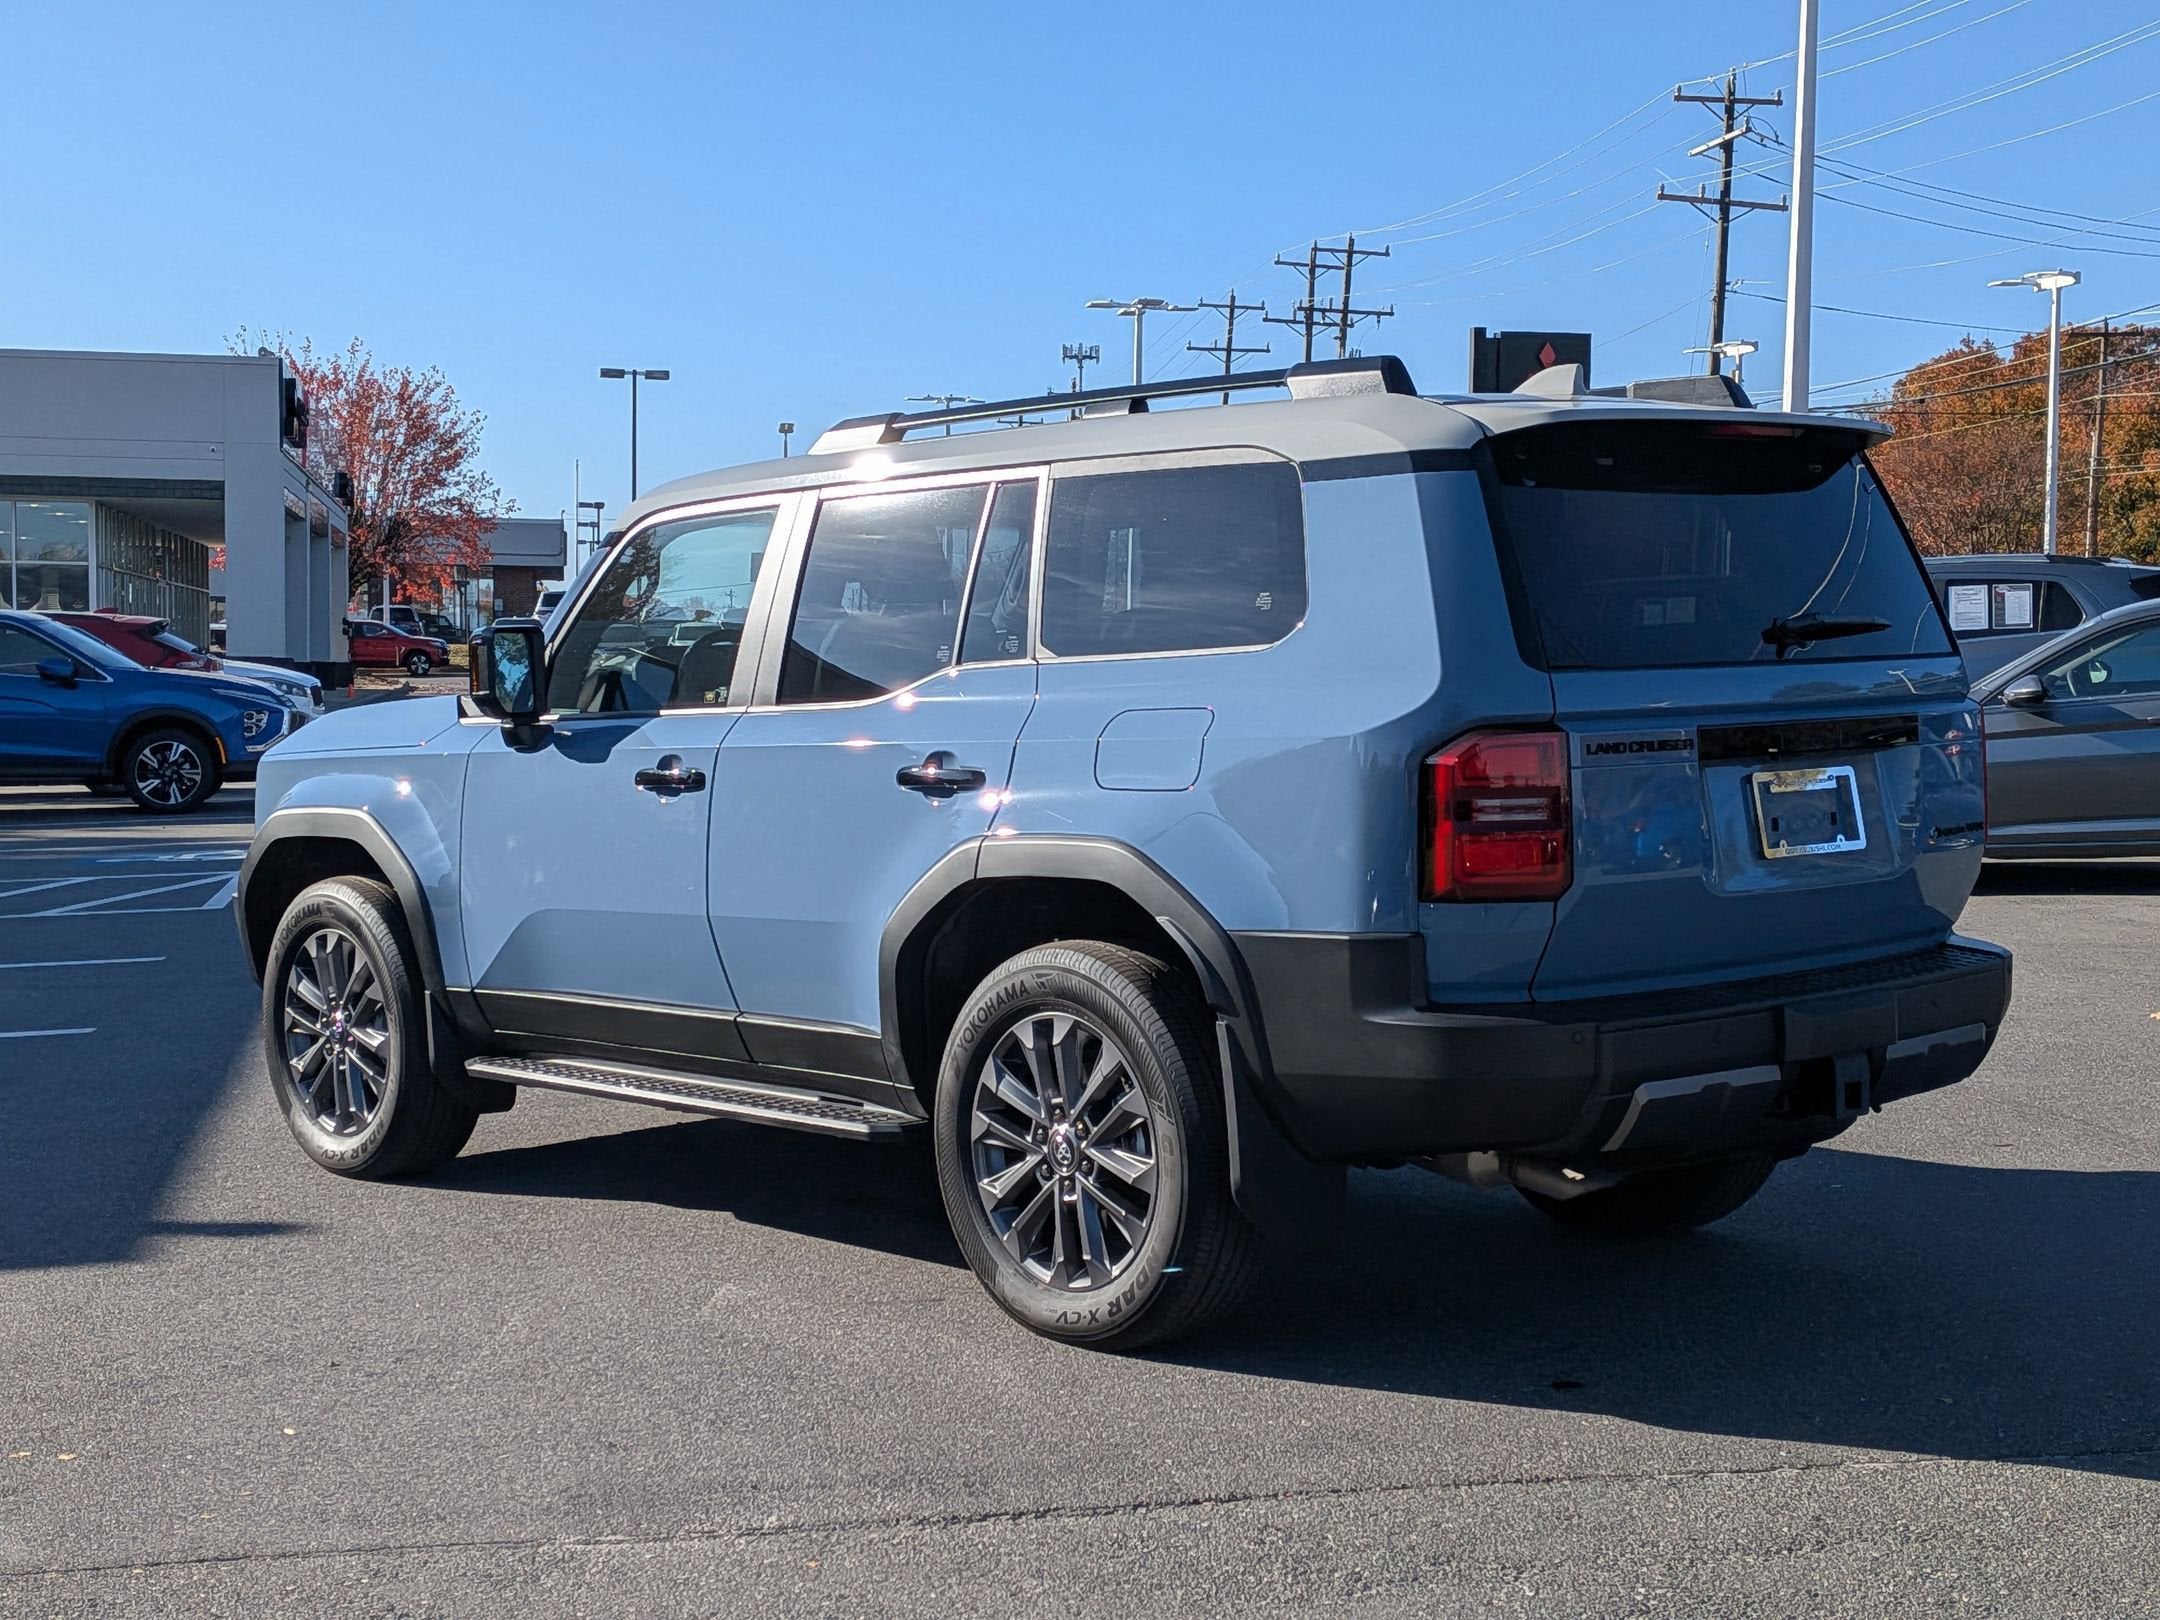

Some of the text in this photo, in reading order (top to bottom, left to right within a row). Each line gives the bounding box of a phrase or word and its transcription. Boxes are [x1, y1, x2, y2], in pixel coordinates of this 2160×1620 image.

[1585, 738, 1695, 756] LAND CRUISER
[278, 902, 323, 946] YOKOHAMA
[957, 979, 1030, 1052] YOKOHAMA
